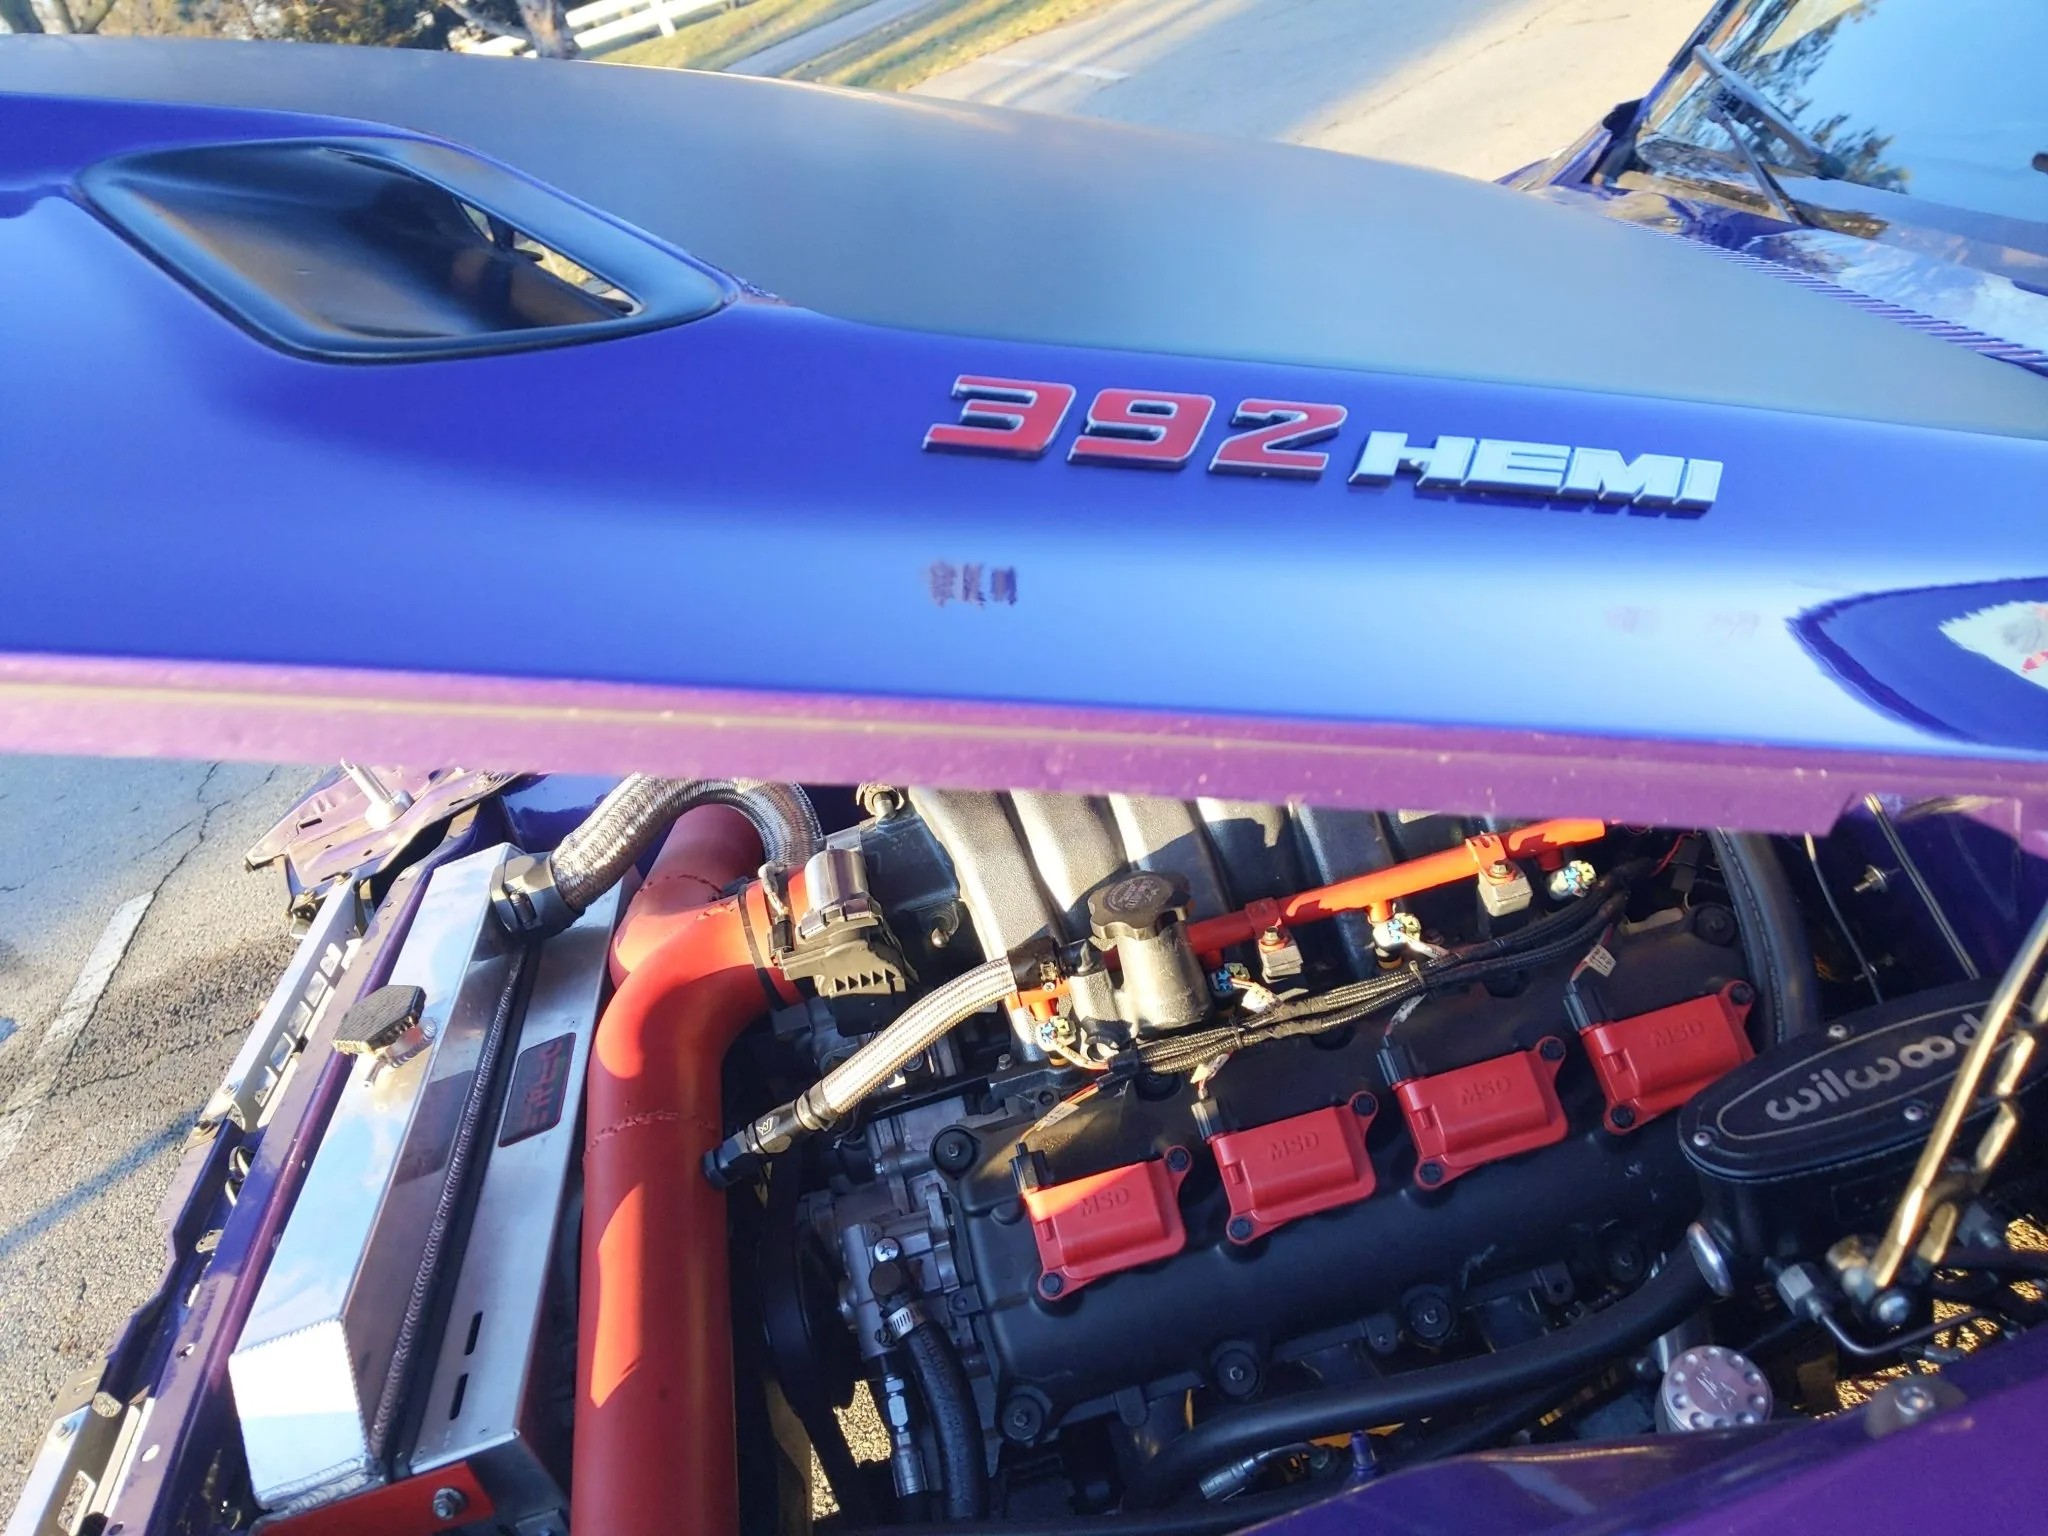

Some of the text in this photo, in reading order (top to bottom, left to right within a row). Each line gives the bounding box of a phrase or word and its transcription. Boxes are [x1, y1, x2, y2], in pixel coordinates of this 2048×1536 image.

[922, 373, 1725, 515] 392 HEMI
[1765, 1012, 1986, 1122] wilwood
[1459, 1074, 1513, 1105] MSD
[1269, 1130, 1320, 1161] MSD
[1079, 1186, 1130, 1217] MSD
